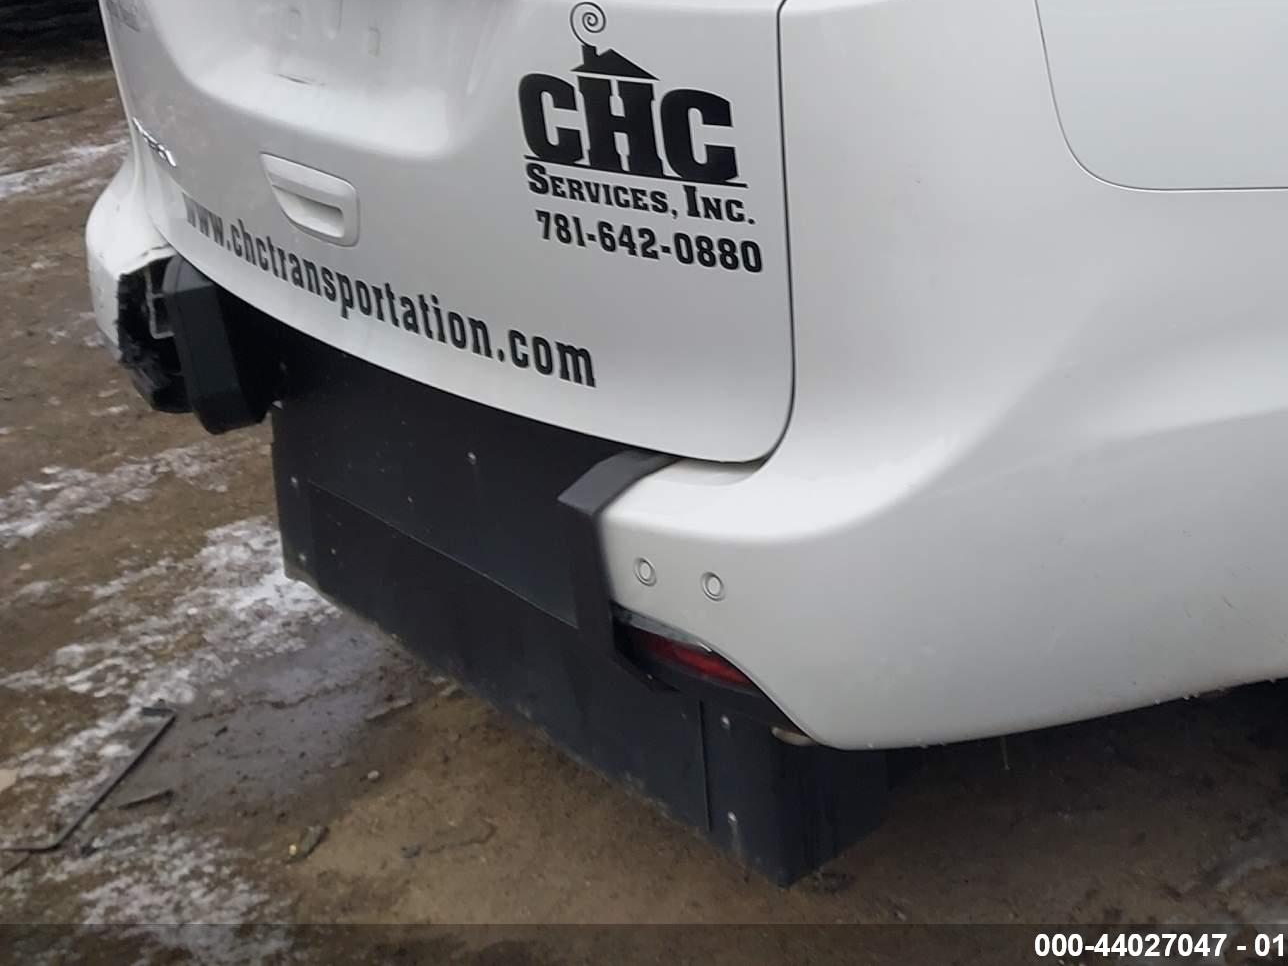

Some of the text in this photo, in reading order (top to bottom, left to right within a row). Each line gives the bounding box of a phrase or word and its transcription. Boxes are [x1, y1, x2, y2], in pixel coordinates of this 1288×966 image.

[518, 72, 740, 182] CHC
[182, 192, 597, 389] www.chctransportation.com
[535, 209, 763, 274] 781-642-0880
